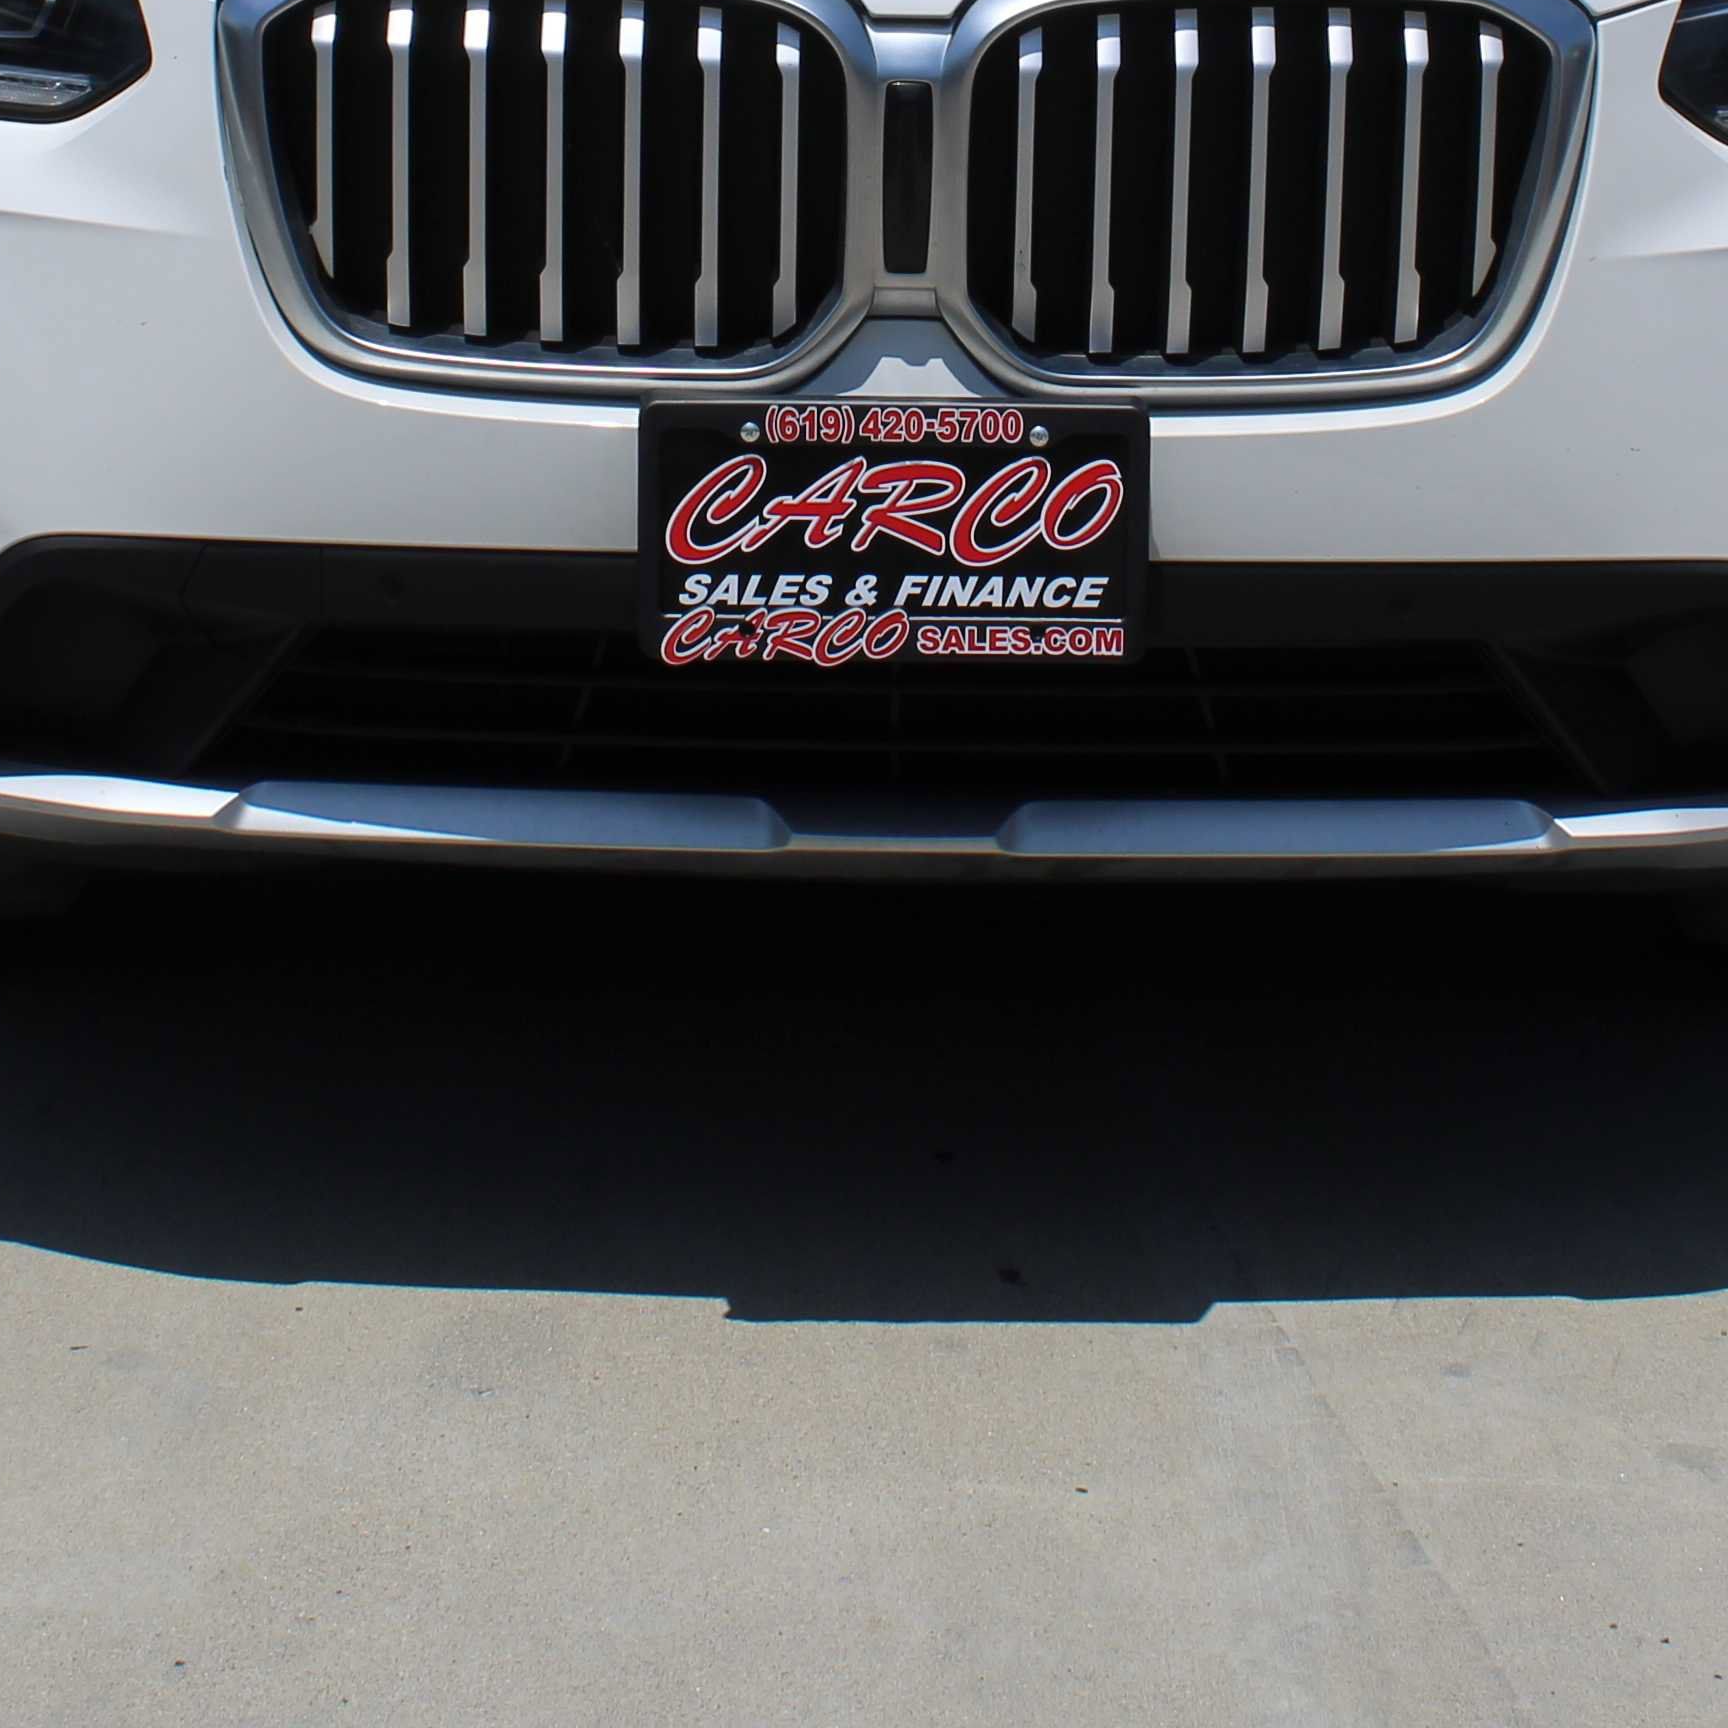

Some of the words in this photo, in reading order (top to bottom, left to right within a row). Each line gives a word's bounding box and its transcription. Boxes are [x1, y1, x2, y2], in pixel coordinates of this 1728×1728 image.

[765, 405, 854, 444] (619)
[860, 408, 1023, 444] 420-5700
[665, 453, 1124, 567] CARCO
[678, 573, 832, 607] SALES
[844, 574, 879, 607] &
[893, 575, 1110, 609] FINANCE
[661, 606, 910, 666] CARCO
[916, 626, 1124, 657] SALES.COM
